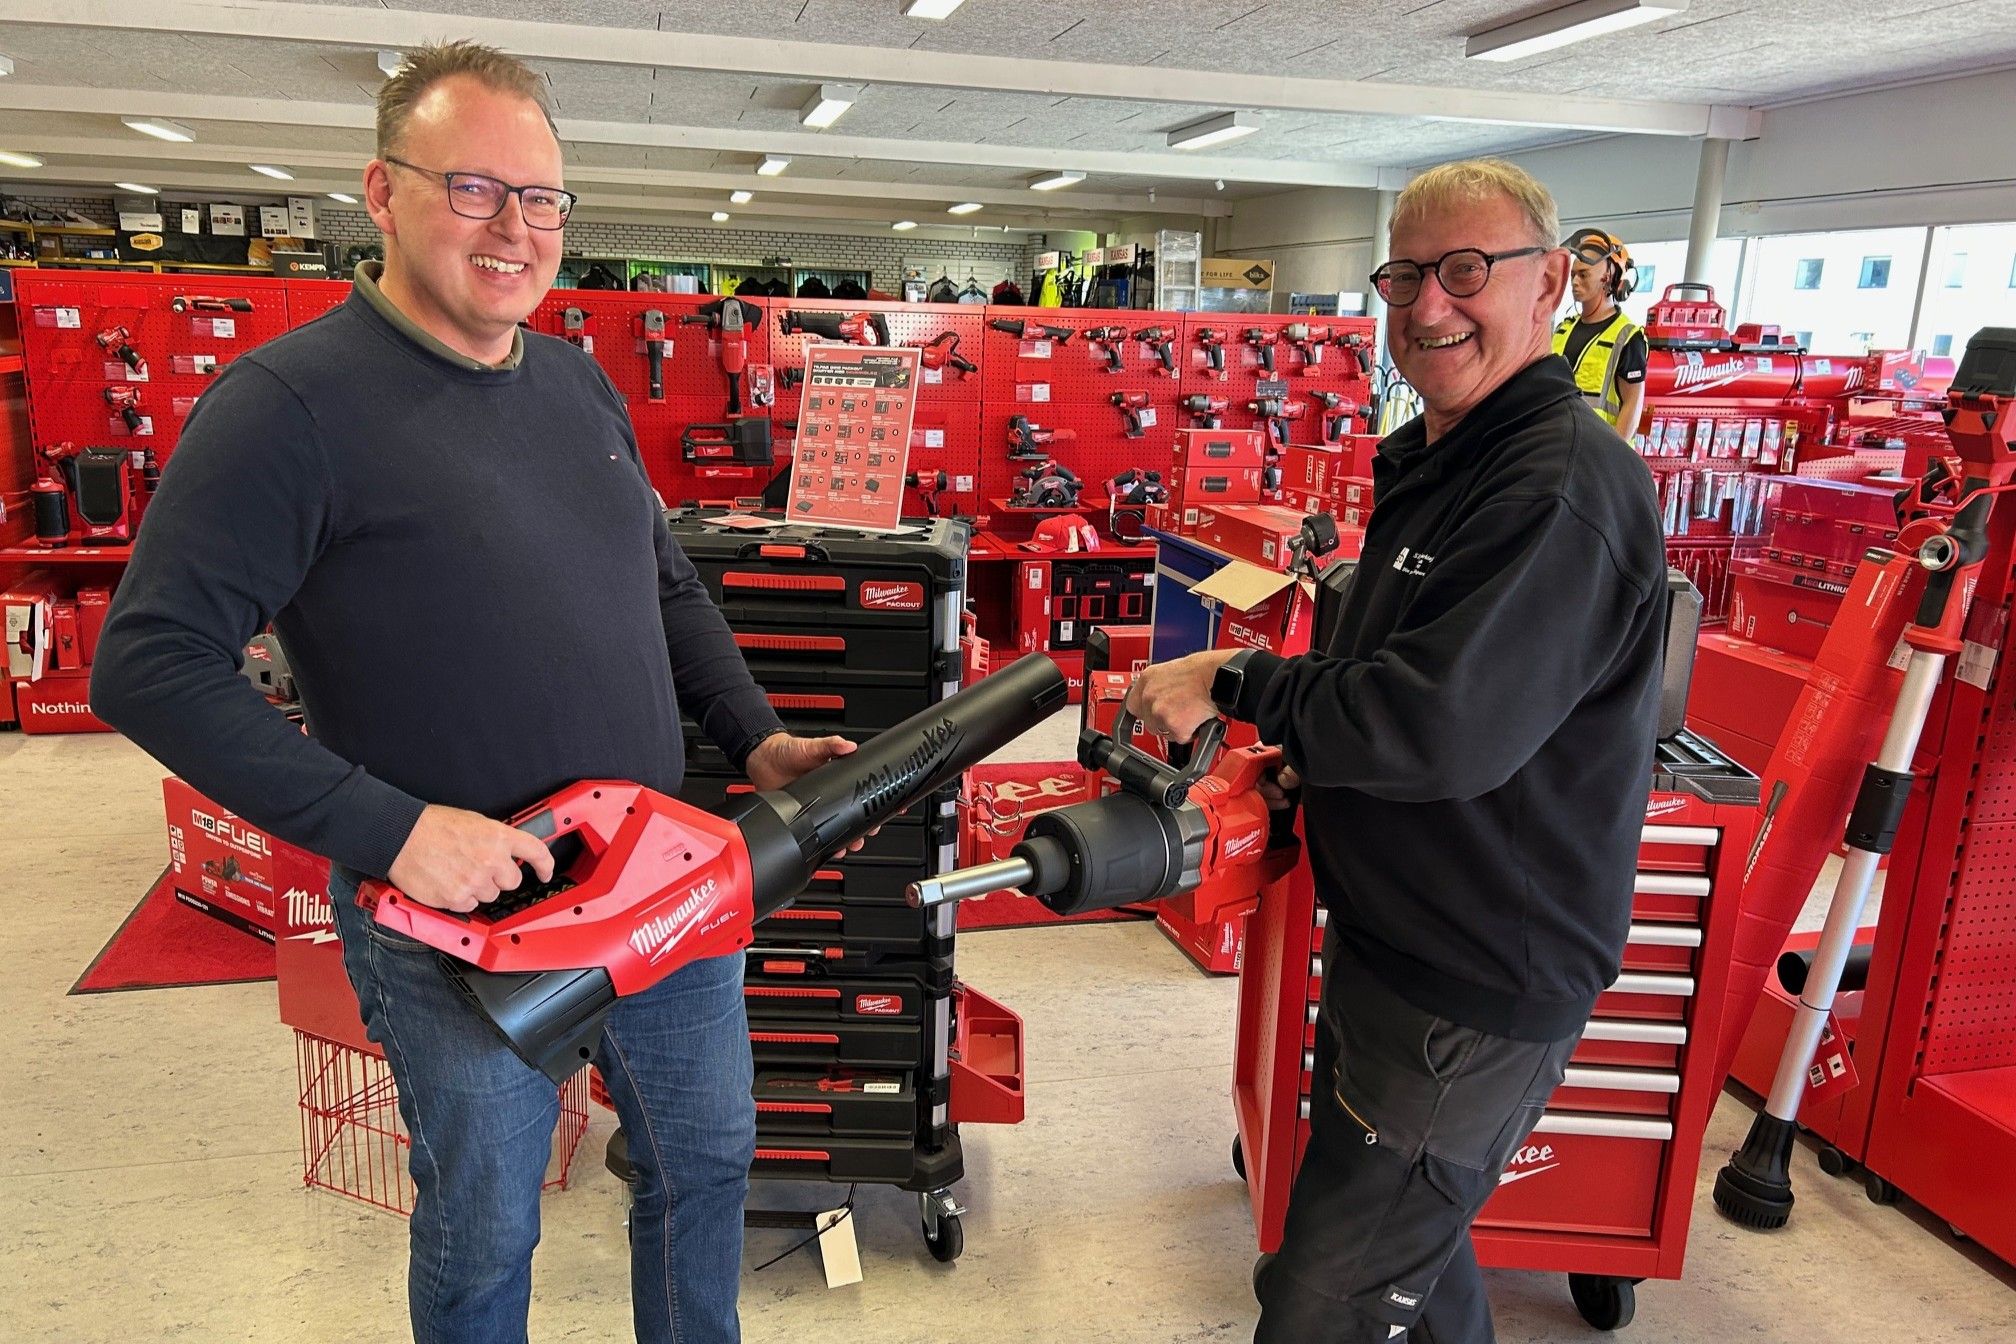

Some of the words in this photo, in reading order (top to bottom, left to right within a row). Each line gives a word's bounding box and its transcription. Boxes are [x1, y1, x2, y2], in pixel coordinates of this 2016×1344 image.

[1109, 248, 1128, 260] KANSAS
[1673, 357, 1745, 389] Milwauke
[864, 585, 909, 601] Milwaukee
[1242, 627, 1273, 650] FUEL
[32, 702, 91, 714] Nothin
[851, 718, 958, 821] Milwaukee
[1646, 796, 1686, 811] ilwaukee
[194, 812, 214, 831] M18
[216, 819, 272, 857] FUEL
[628, 878, 717, 957] Milwaukee
[700, 910, 740, 936] FUEL
[1390, 1292, 1418, 1307] KANSAS
